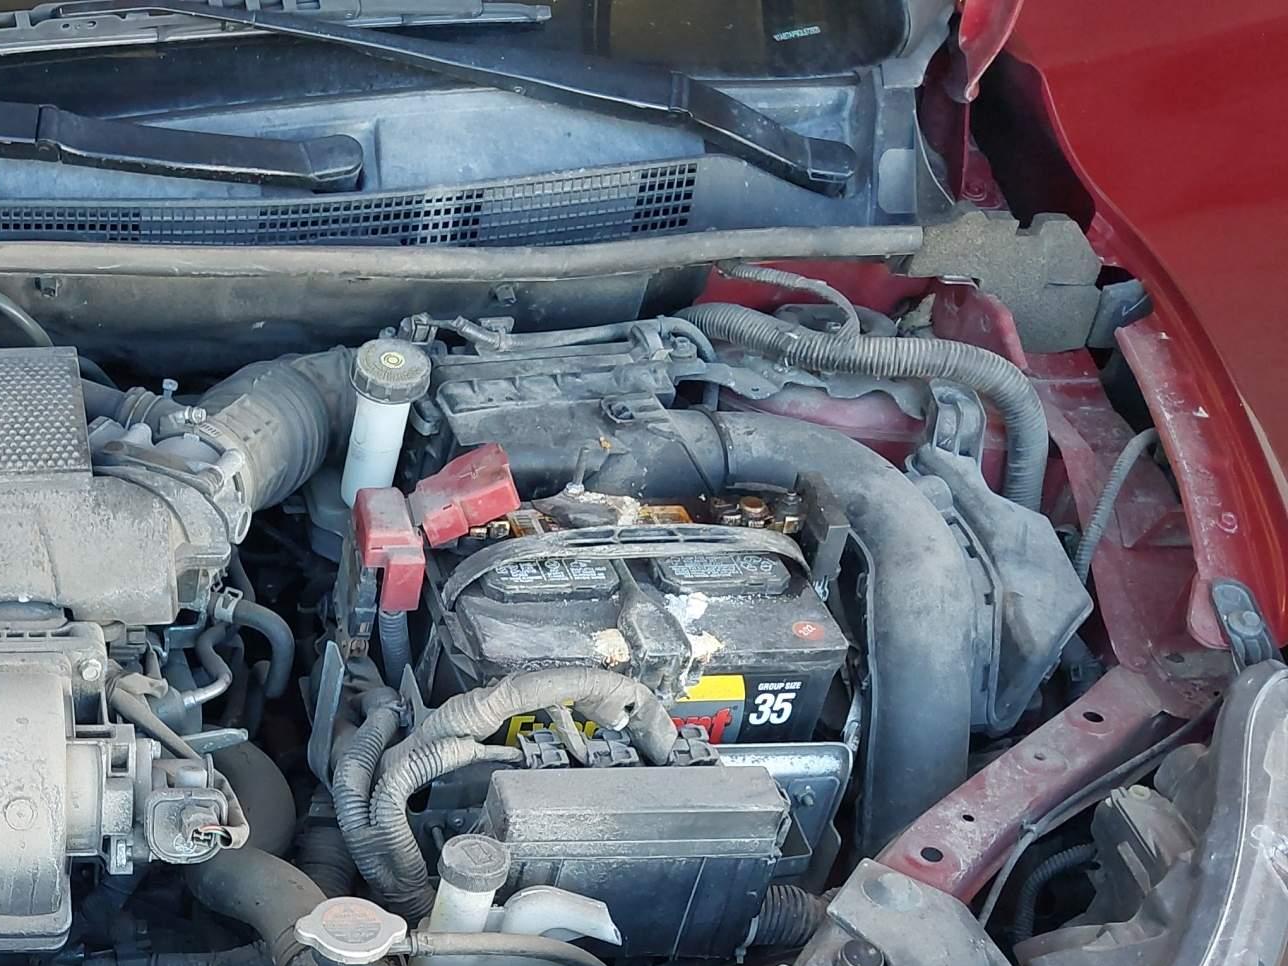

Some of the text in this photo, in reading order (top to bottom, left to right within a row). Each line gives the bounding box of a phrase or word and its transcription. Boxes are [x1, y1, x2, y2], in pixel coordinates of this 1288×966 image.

[757, 681, 802, 691] GROUP SIZE
[748, 692, 797, 725] 35
